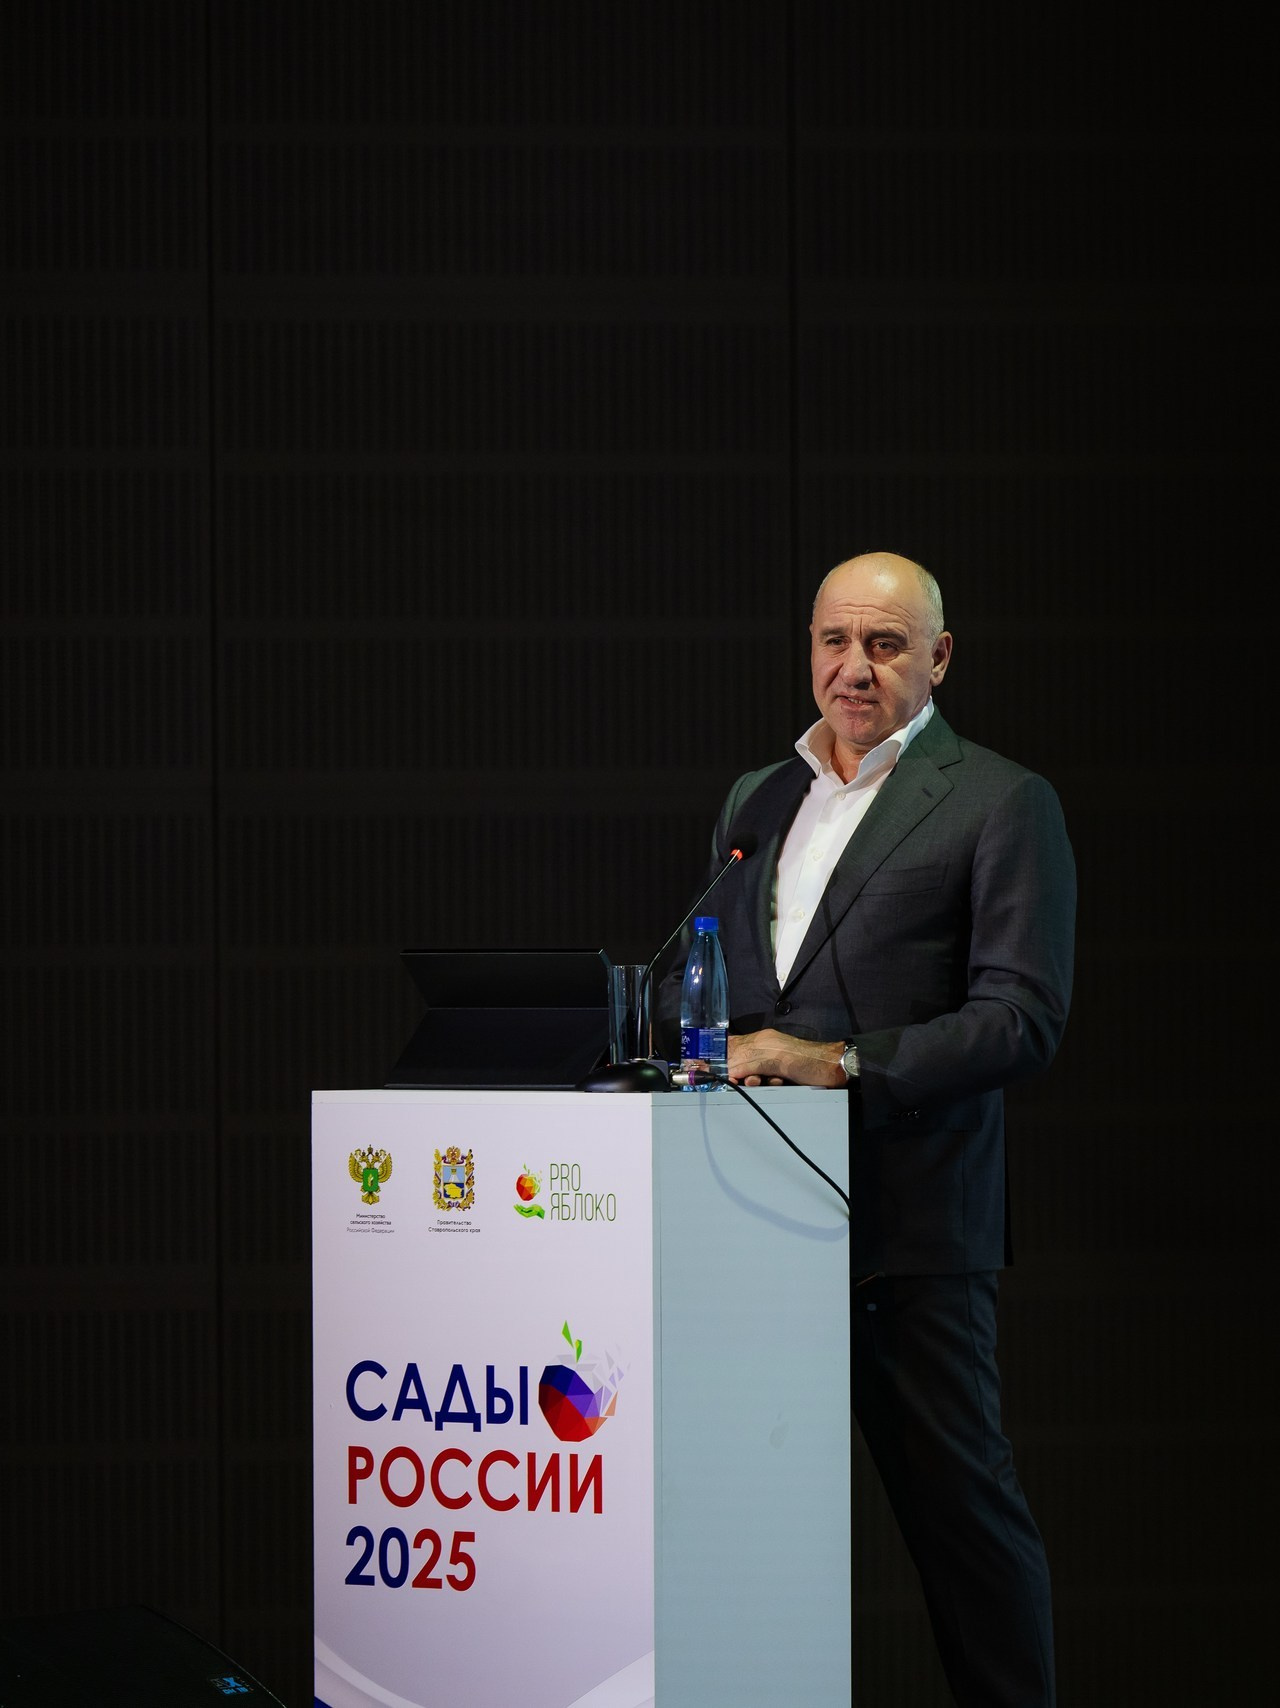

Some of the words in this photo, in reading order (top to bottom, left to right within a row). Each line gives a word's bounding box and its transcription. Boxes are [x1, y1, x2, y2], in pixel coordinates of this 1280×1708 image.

[550, 1163, 581, 1191] PRO
[551, 1193, 616, 1221] ЯБЛОКО
[345, 1360, 529, 1432] САДЫ
[348, 1445, 603, 1515] РОССИИ
[344, 1525, 477, 1592] 2025
